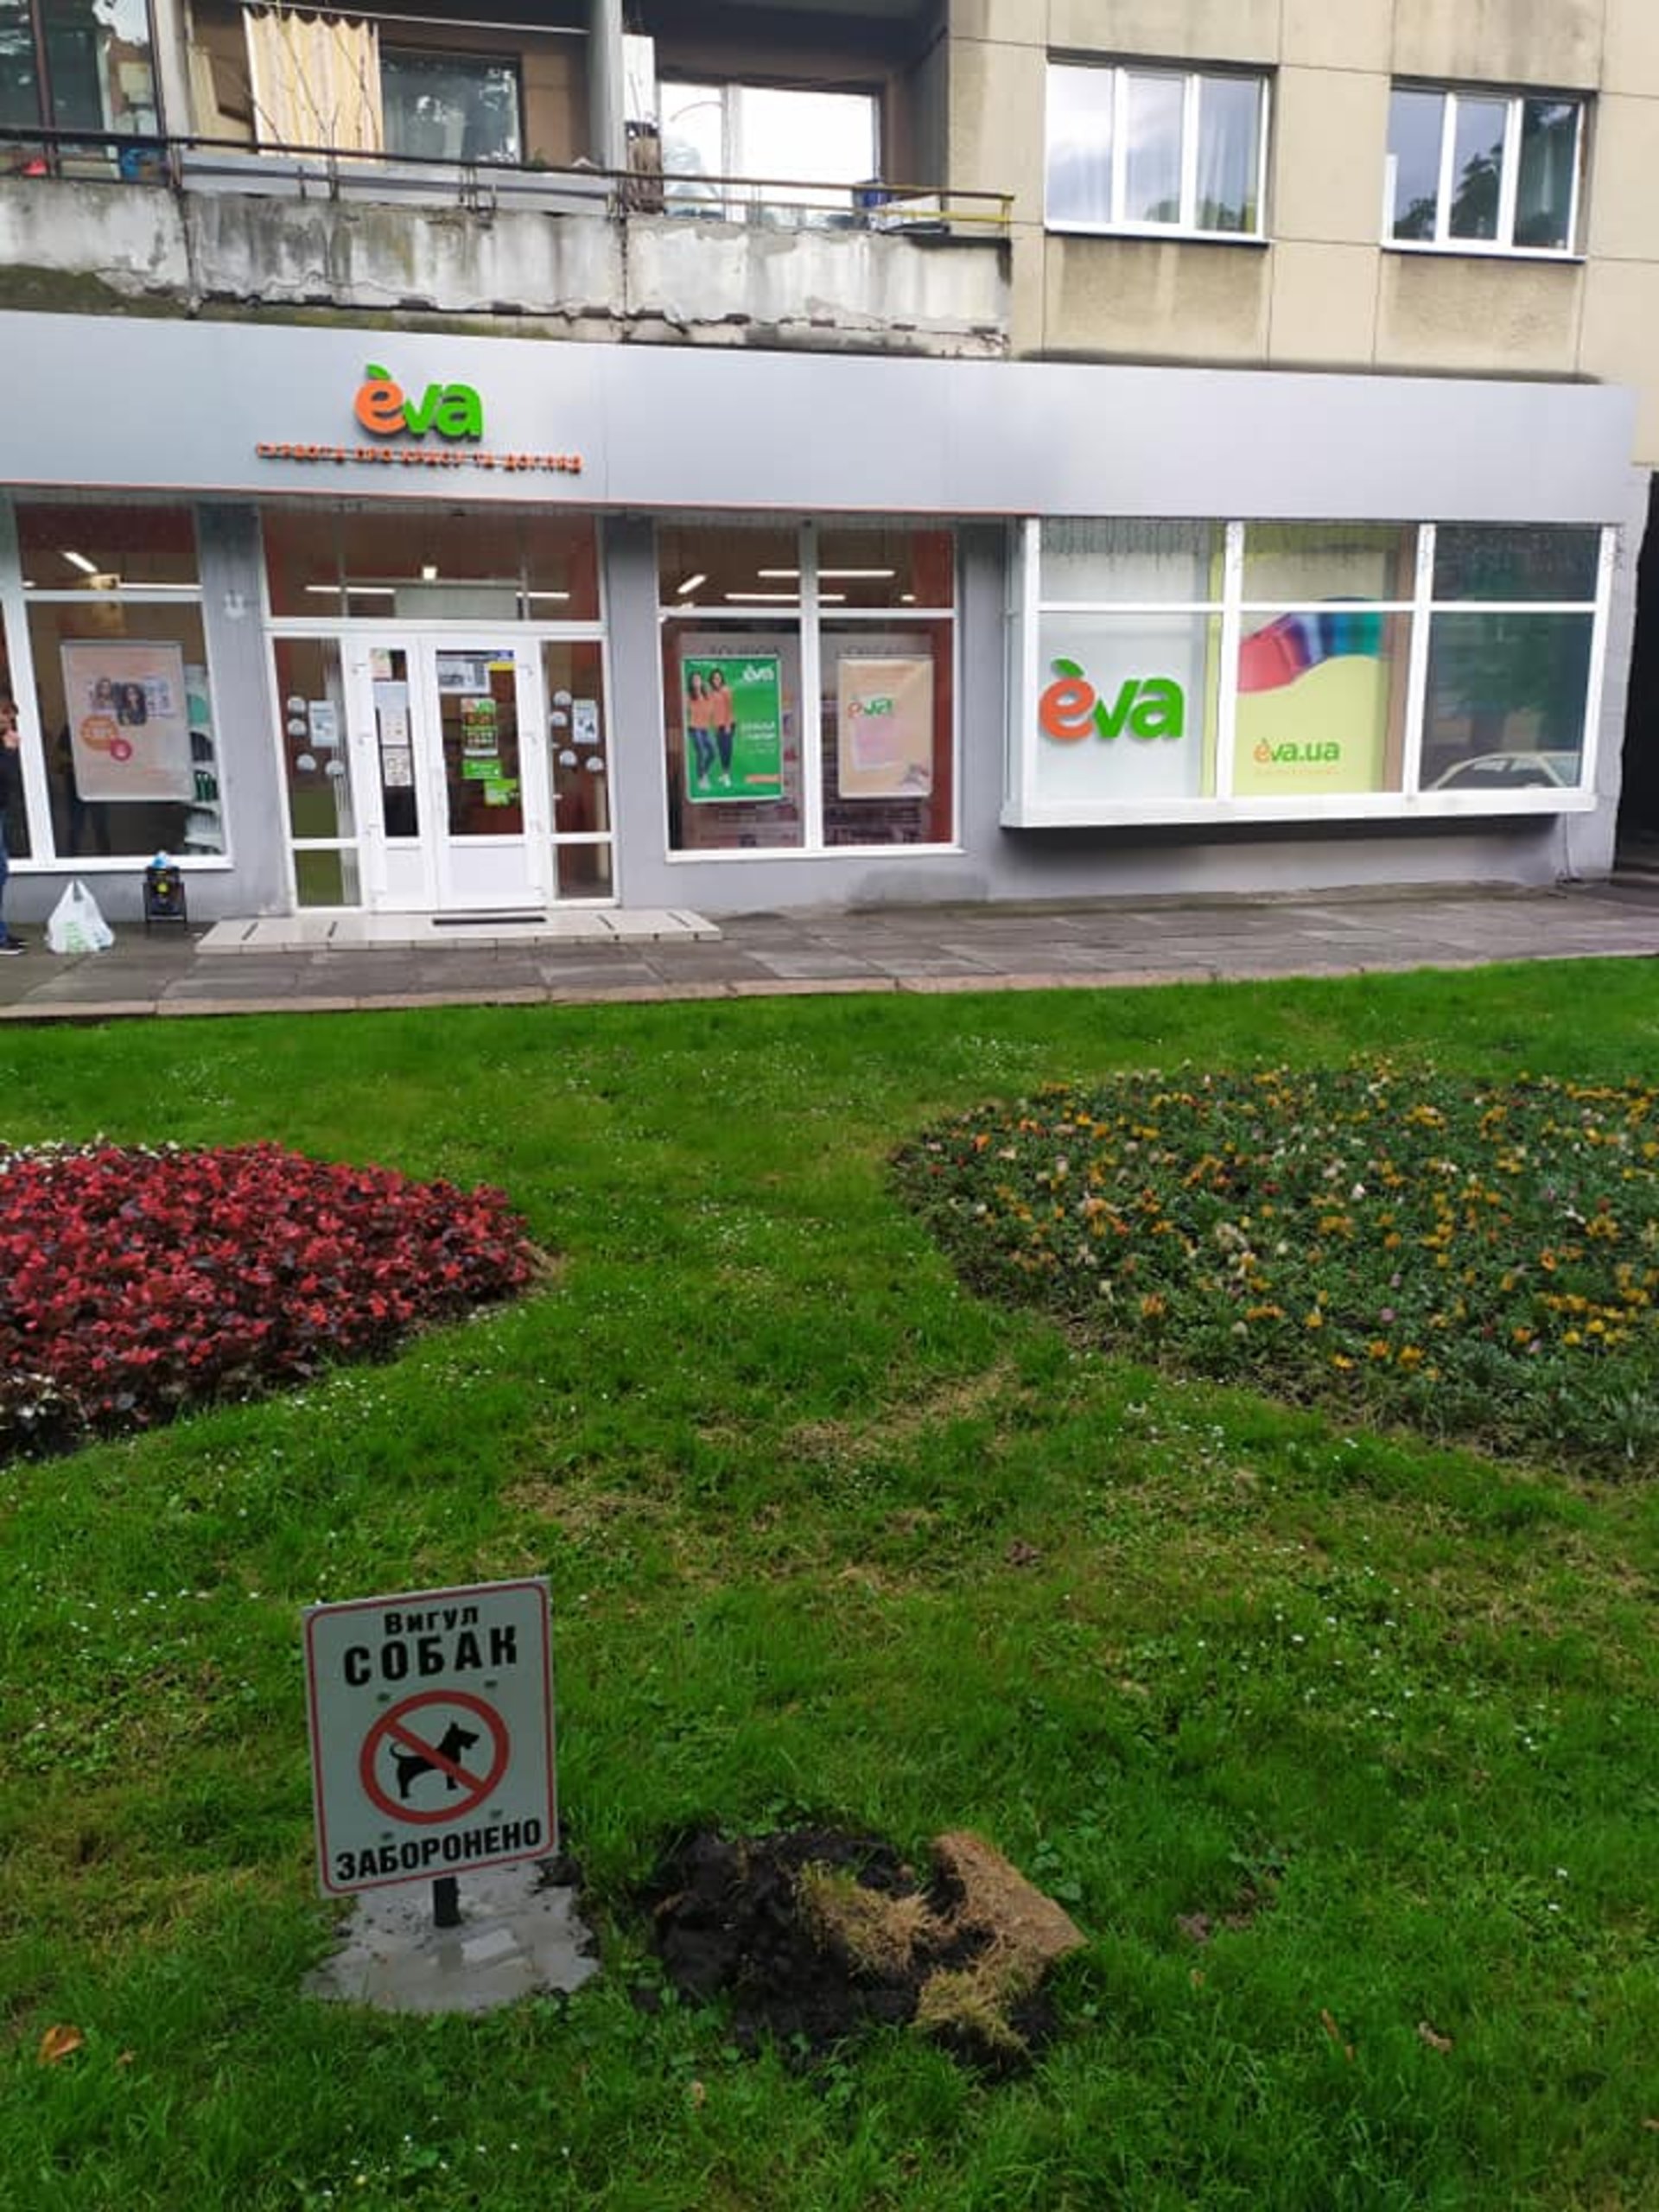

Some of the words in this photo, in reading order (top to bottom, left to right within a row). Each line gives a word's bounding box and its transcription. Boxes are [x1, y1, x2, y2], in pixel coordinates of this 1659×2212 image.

[385, 1606, 479, 1636] Вигул
[345, 1625, 517, 1686] СОБАК
[336, 1819, 541, 1881] ЗАБОРОНЕНО
